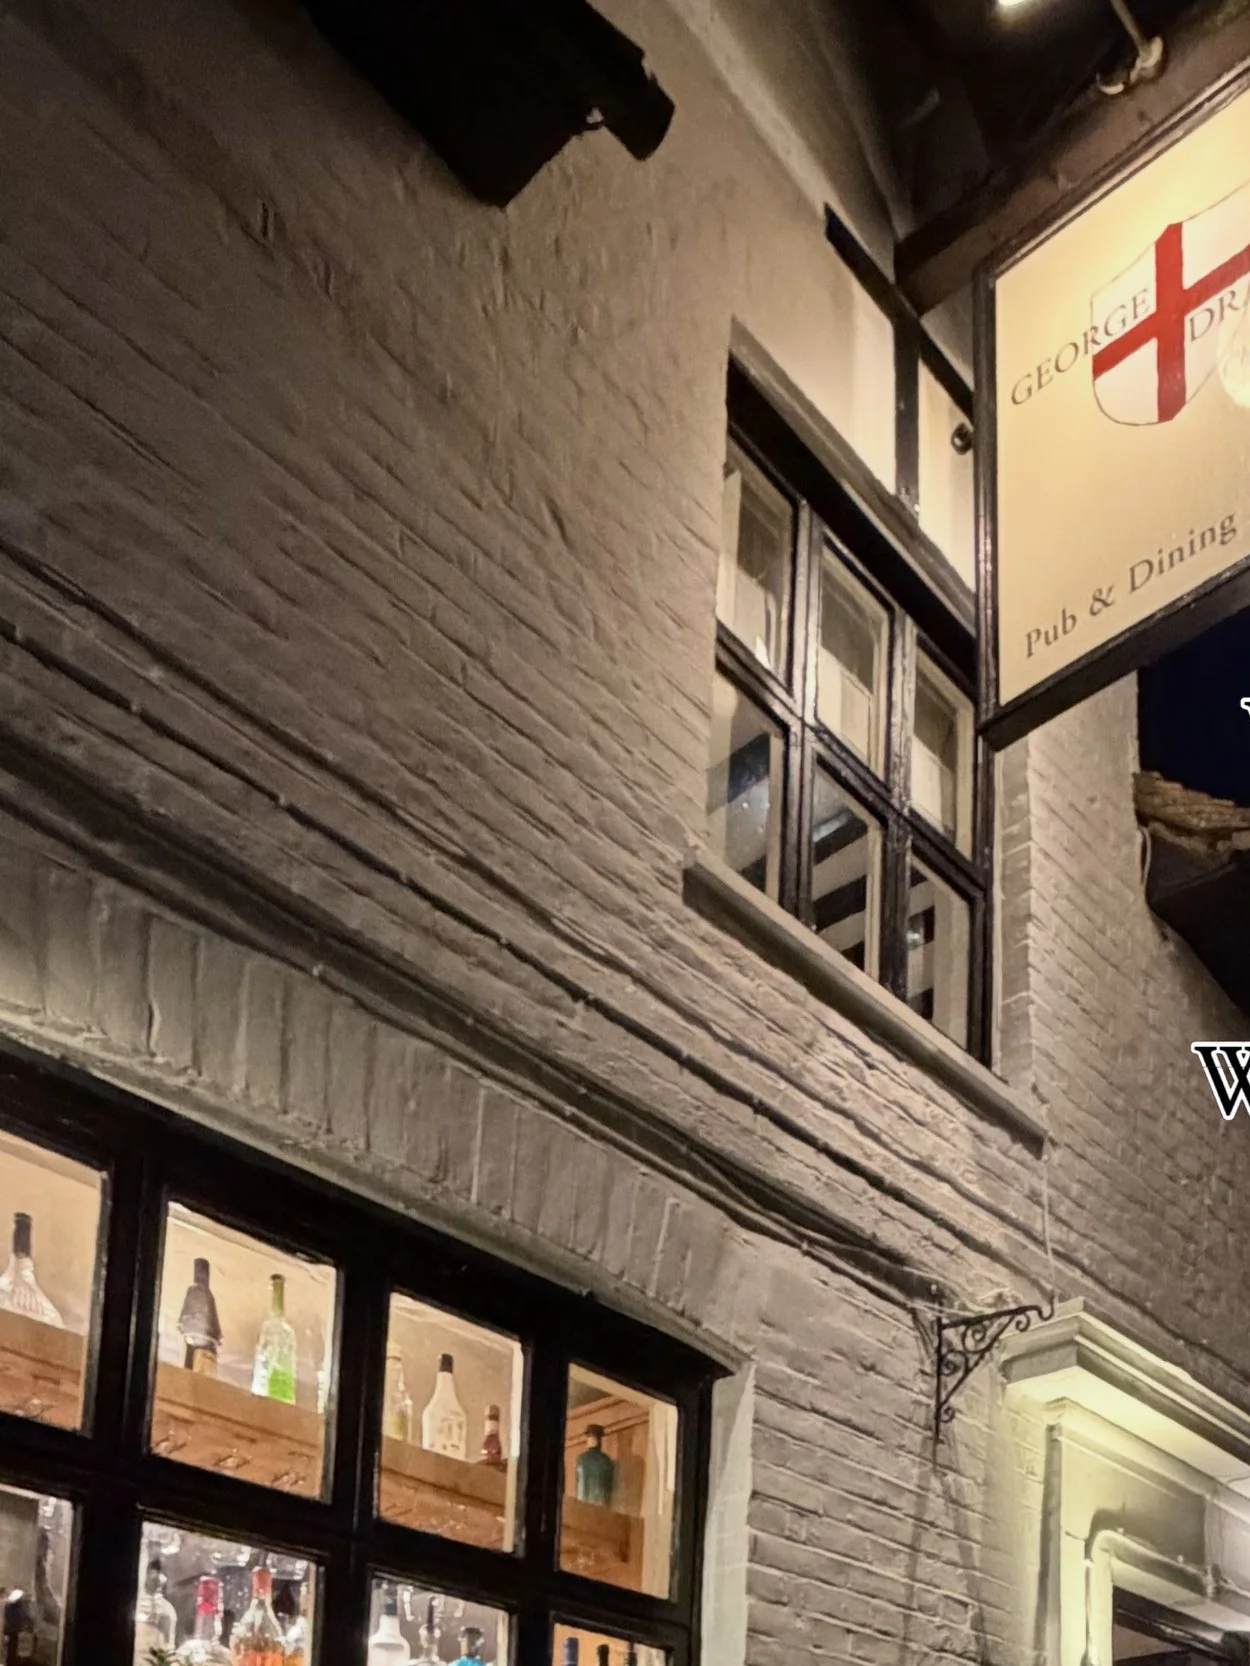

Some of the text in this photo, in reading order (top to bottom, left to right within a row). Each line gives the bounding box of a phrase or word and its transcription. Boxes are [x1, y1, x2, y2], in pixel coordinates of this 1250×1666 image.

[1011, 287, 1151, 406] GEORGE
[1025, 608, 1077, 659] Pub
[1088, 579, 1116, 615] &
[1128, 513, 1238, 594] Dining
